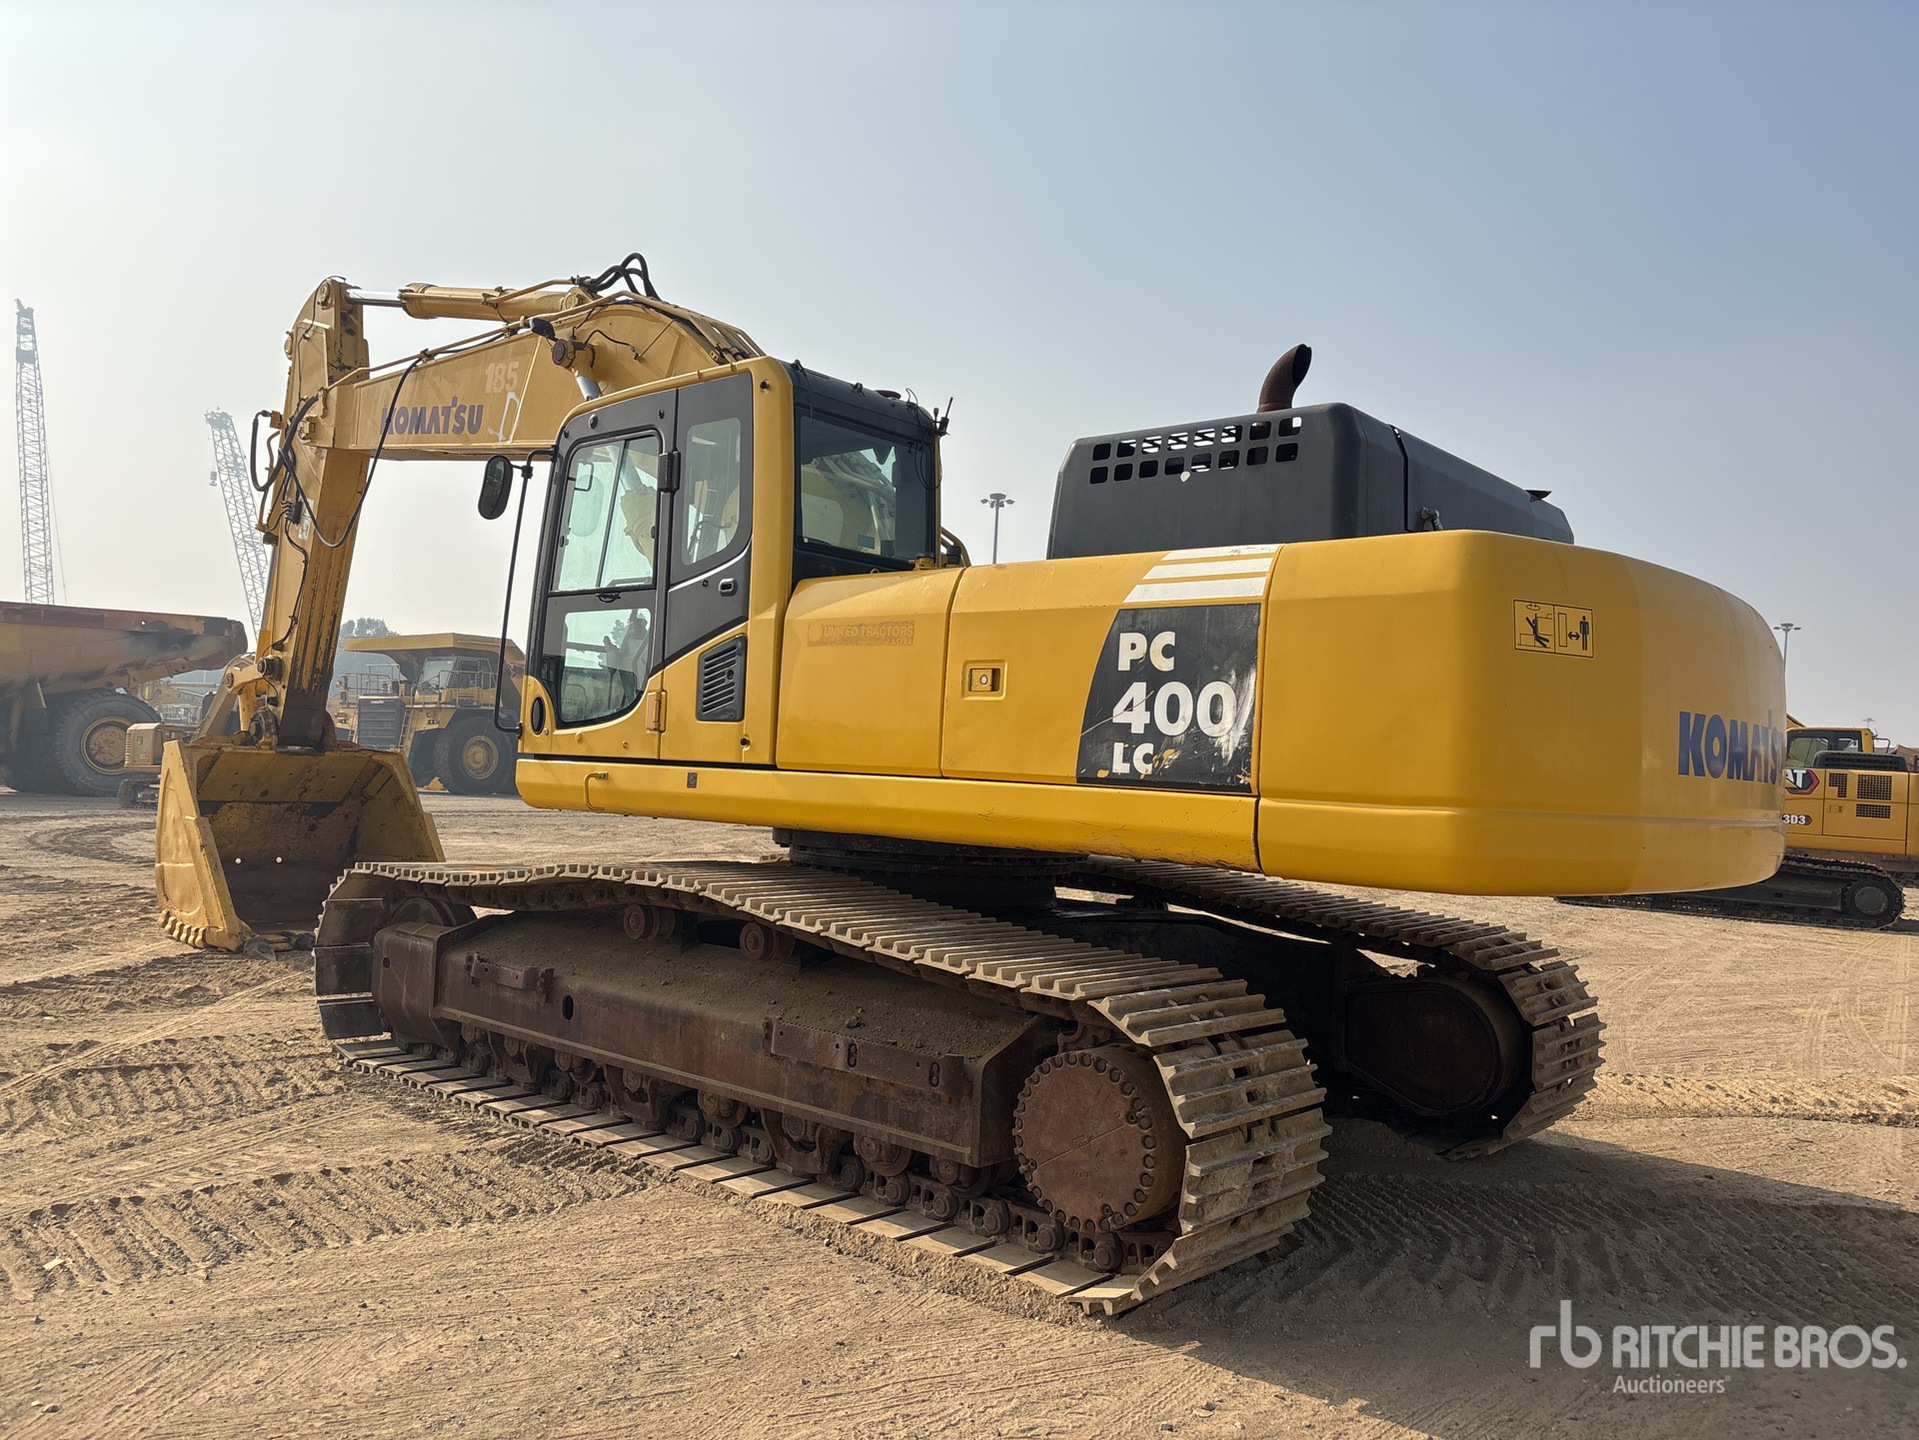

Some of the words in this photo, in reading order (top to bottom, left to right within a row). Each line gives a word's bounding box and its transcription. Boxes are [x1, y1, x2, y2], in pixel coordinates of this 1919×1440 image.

[485, 361, 520, 394] 185
[860, 625, 914, 637] TRACTORS
[1118, 631, 1176, 672] PC
[1112, 681, 1237, 737] 400
[1112, 742, 1155, 774] LC
